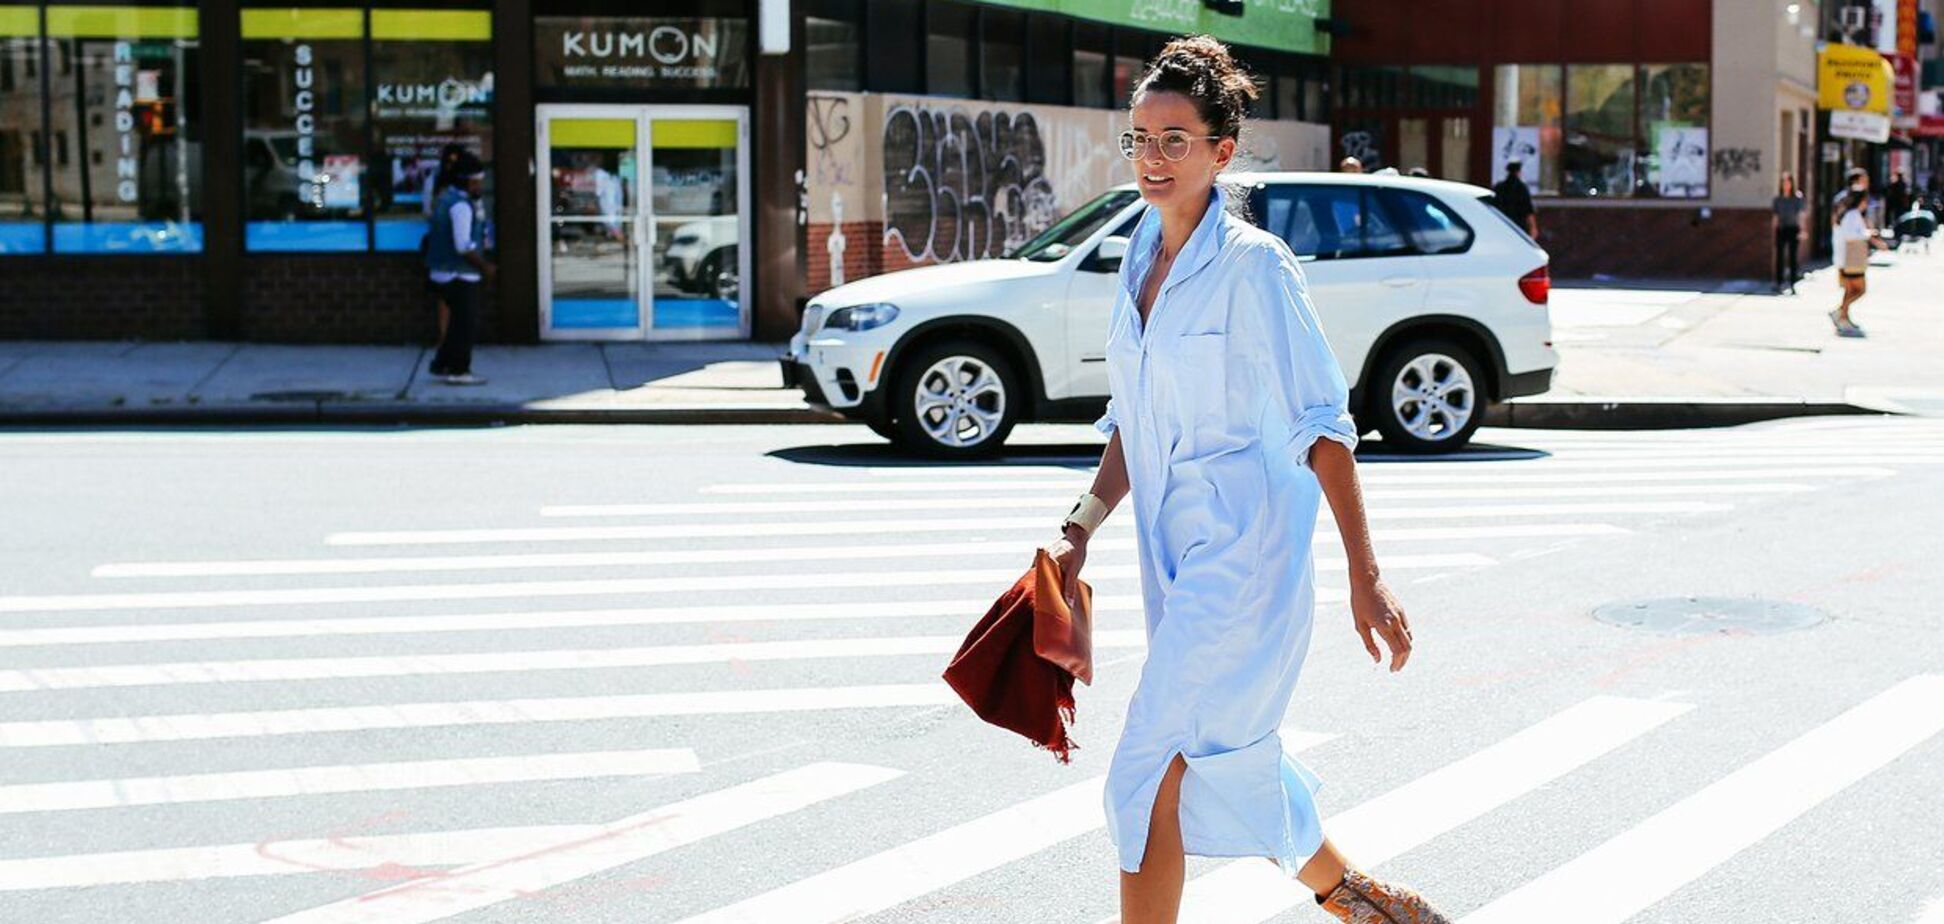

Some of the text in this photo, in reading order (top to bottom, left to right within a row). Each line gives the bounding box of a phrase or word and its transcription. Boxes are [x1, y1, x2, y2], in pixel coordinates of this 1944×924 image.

[377, 79, 489, 108] KUMON
[563, 26, 717, 64] KUMON
[115, 41, 137, 201] READING
[296, 44, 314, 203] SUCCESS
